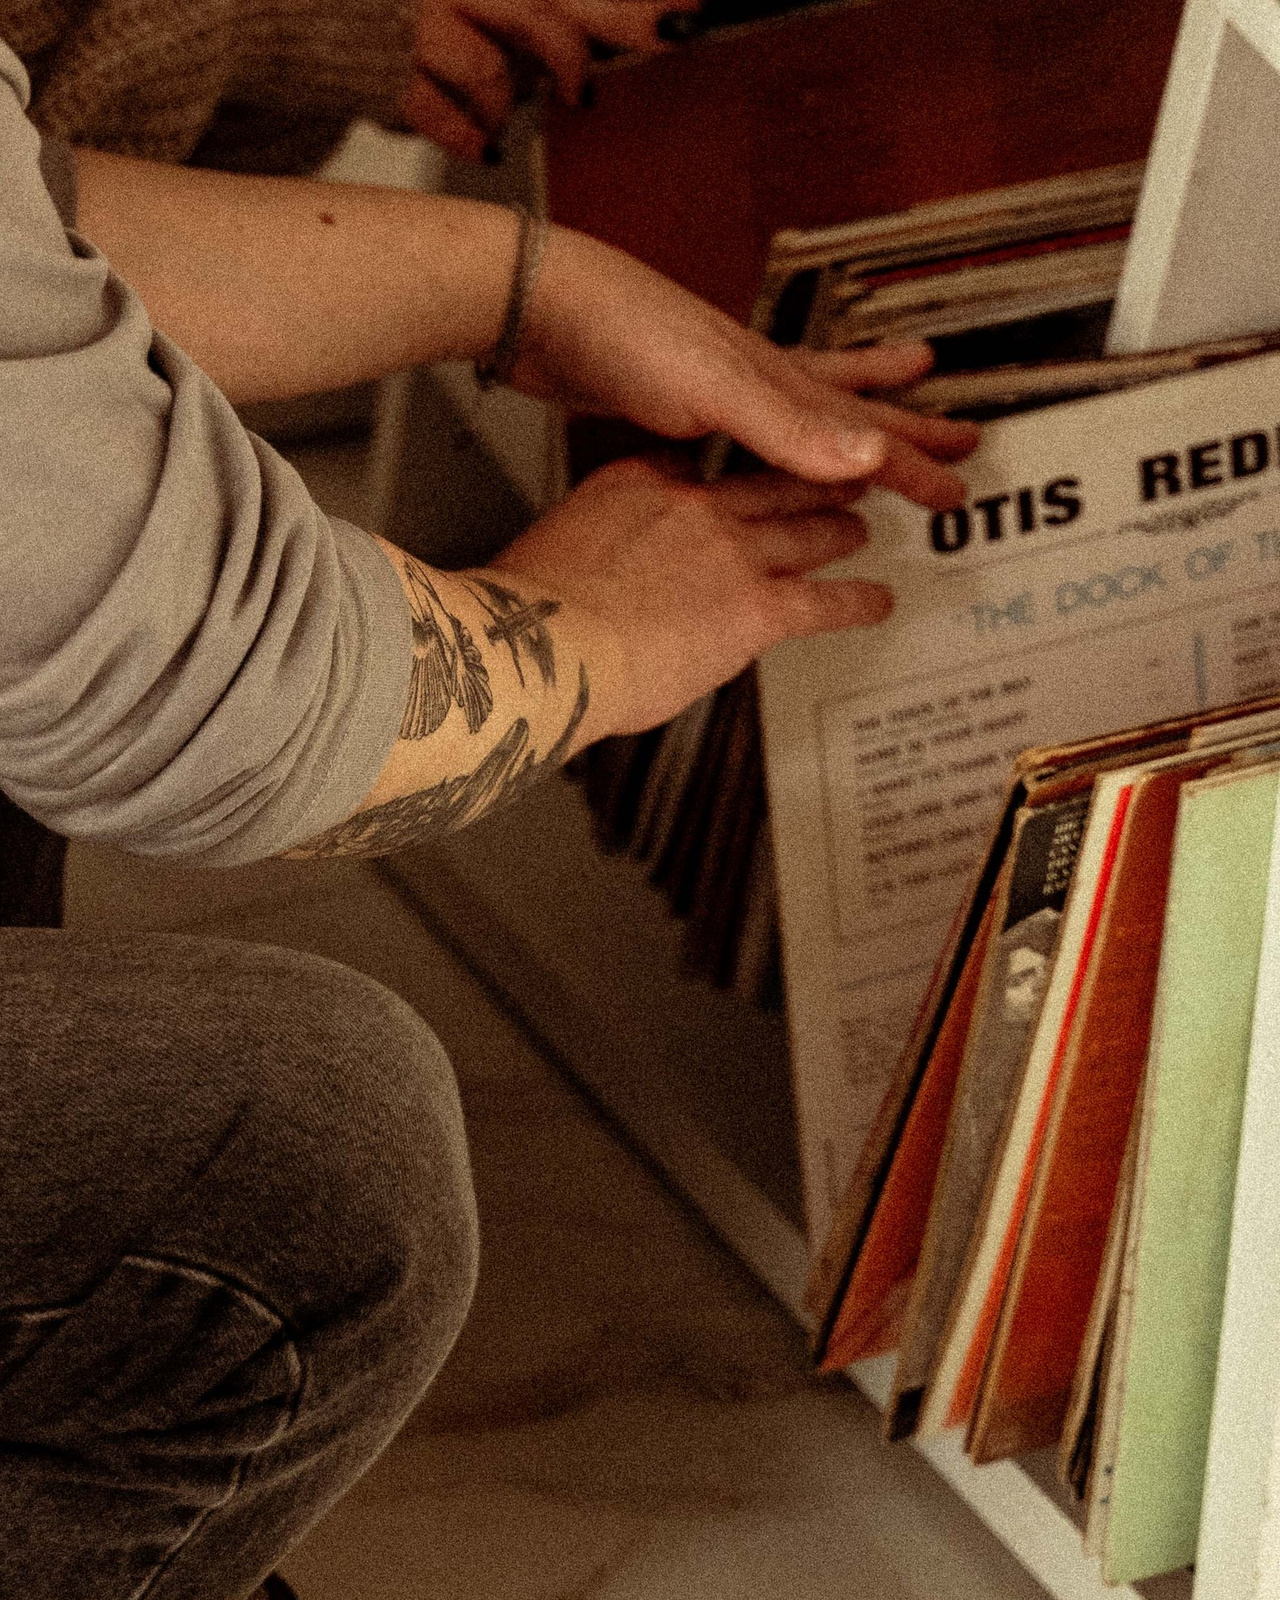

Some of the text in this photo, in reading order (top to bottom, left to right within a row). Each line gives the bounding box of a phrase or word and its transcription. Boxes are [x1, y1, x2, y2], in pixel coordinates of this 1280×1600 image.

[930, 475, 1083, 553] OTIS
[1138, 422, 1280, 503] RED
[971, 590, 1036, 634] THE
[1056, 560, 1166, 616] DOCK
[1184, 540, 1234, 582] OF
